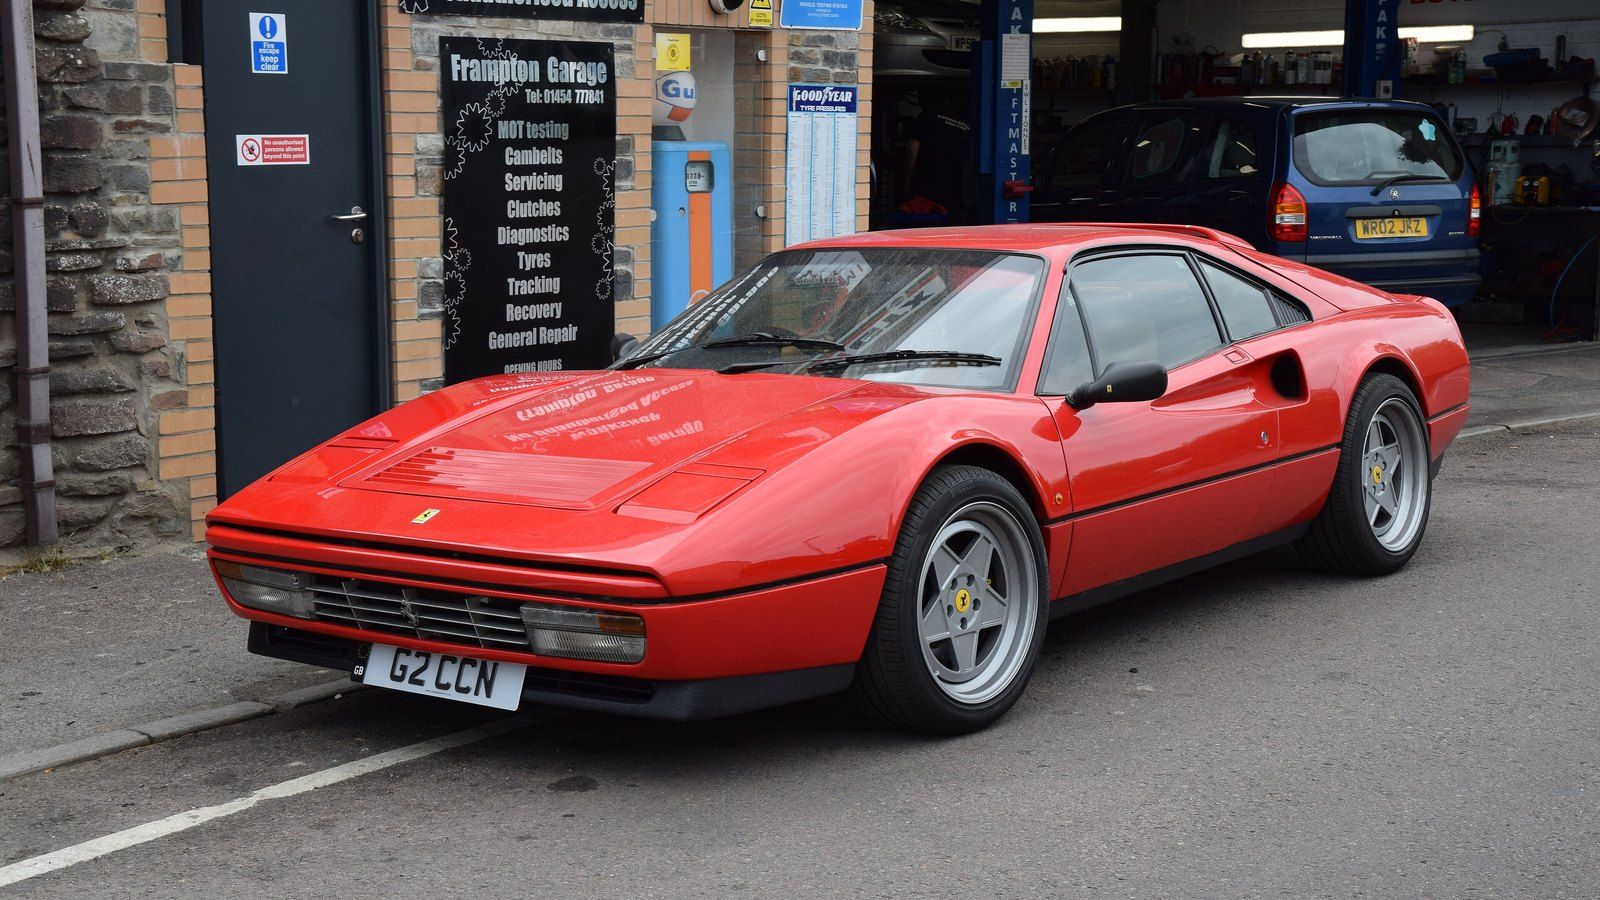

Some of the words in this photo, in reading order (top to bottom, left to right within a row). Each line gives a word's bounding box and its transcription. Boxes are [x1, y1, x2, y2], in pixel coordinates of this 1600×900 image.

[260, 54, 279, 64] keep
[260, 63, 280, 71] clear
[450, 53, 540, 84] Frampton
[547, 56, 607, 86] Garage
[525, 89, 543, 104] Tel:
[544, 89, 572, 104] 01454
[575, 89, 605, 104] 777841
[661, 79, 697, 99] Gu
[793, 87, 853, 104] GOODYEAR
[498, 120, 524, 139] MOT
[526, 120, 569, 140] testing
[505, 146, 563, 166] Cambelts
[504, 172, 563, 192] Servicing
[507, 199, 561, 219] Clutches
[497, 224, 570, 246] Diagnostics
[1362, 219, 1395, 235] WR02
[517, 251, 551, 271] Tyres
[507, 276, 561, 296] Tracking
[506, 302, 563, 322] Recovery
[488, 327, 537, 350] General
[539, 324, 578, 345] Repair
[504, 361, 536, 374] OPENING
[537, 359, 562, 371] HOURS
[353, 665, 364, 676] GB
[389, 647, 431, 686] G2
[434, 654, 499, 699] CCN
